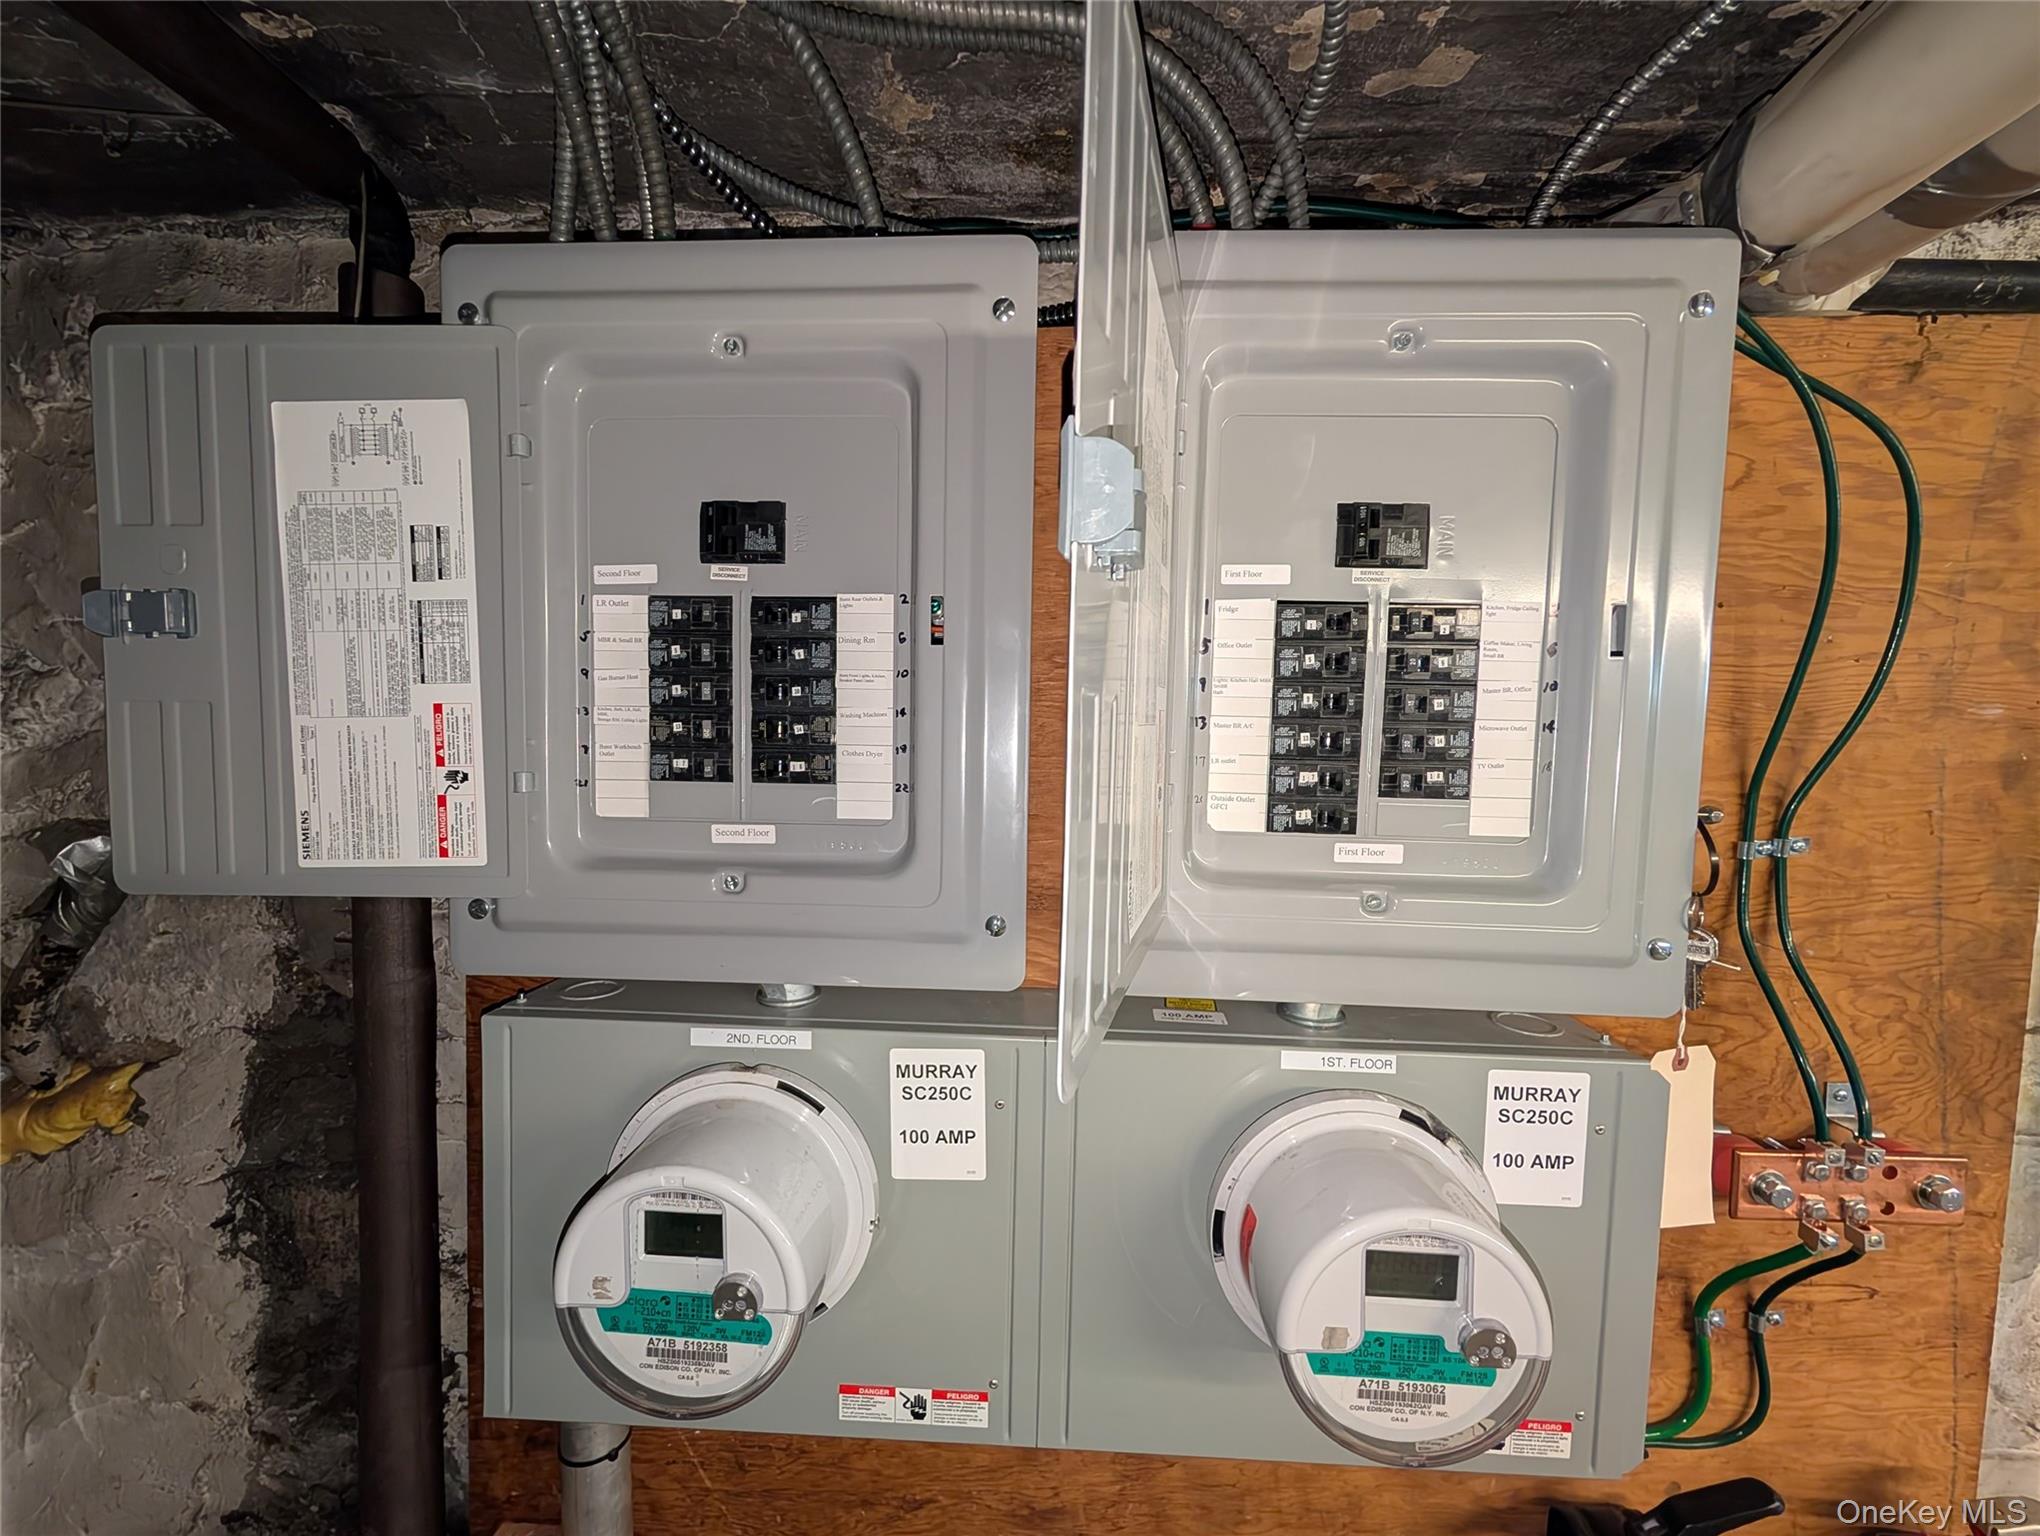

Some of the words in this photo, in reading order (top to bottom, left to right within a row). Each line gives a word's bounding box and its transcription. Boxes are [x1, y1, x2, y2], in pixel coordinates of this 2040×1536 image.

[1436, 515, 1455, 556] MAIN
[597, 570, 622, 578] Second
[580, 594, 585, 606] 1
[900, 594, 910, 604] 2
[1205, 598, 1209, 615] 1
[1218, 606, 1239, 614] Fridge
[580, 630, 591, 642] 5
[838, 636, 862, 646] Dining
[898, 632, 907, 644] 6
[1199, 638, 1211, 655] 5
[580, 668, 589, 680] 9
[896, 670, 909, 678] 10
[1194, 716, 1207, 730] 13
[434, 714, 443, 746] PELIGRO
[1195, 756, 1206, 767] 17
[895, 783, 910, 793] 22
[1402, 780, 1409, 788] 20
[439, 806, 447, 838] DANGER
[302, 810, 312, 860] SIEMENS
[715, 828, 745, 836] Second
[747, 828, 770, 837] Floor
[1338, 847, 1358, 856] First
[1360, 847, 1385, 856] Floor
[726, 1033, 753, 1044] 2ND.
[756, 1034, 797, 1045] FLOOR
[1320, 1056, 1346, 1068] 1ST.
[1350, 1058, 1392, 1070] FLOOR
[896, 1064, 978, 1079] MURRAY
[902, 1086, 972, 1101] SC250C
[1493, 1086, 1582, 1103] MURRAY
[1498, 1108, 1574, 1125] SC250C
[899, 1130, 930, 1144] 100
[934, 1130, 976, 1144] AMP
[1492, 1153, 1525, 1168] 100
[1530, 1154, 1575, 1170] AMP
[647, 1337, 676, 1348] A71B
[683, 1340, 728, 1352] 5192358
[1398, 1366, 1417, 1374] 120V
[1460, 1371, 1488, 1380] FM12S
[858, 1388, 890, 1396] DANGER
[1358, 1379, 1390, 1390] A71B
[1398, 1382, 1446, 1394] 5193062
[946, 1392, 980, 1400] PELIGRO
[1367, 1406, 1393, 1414] EDISON
[1528, 1422, 1562, 1431] PELIGRO
